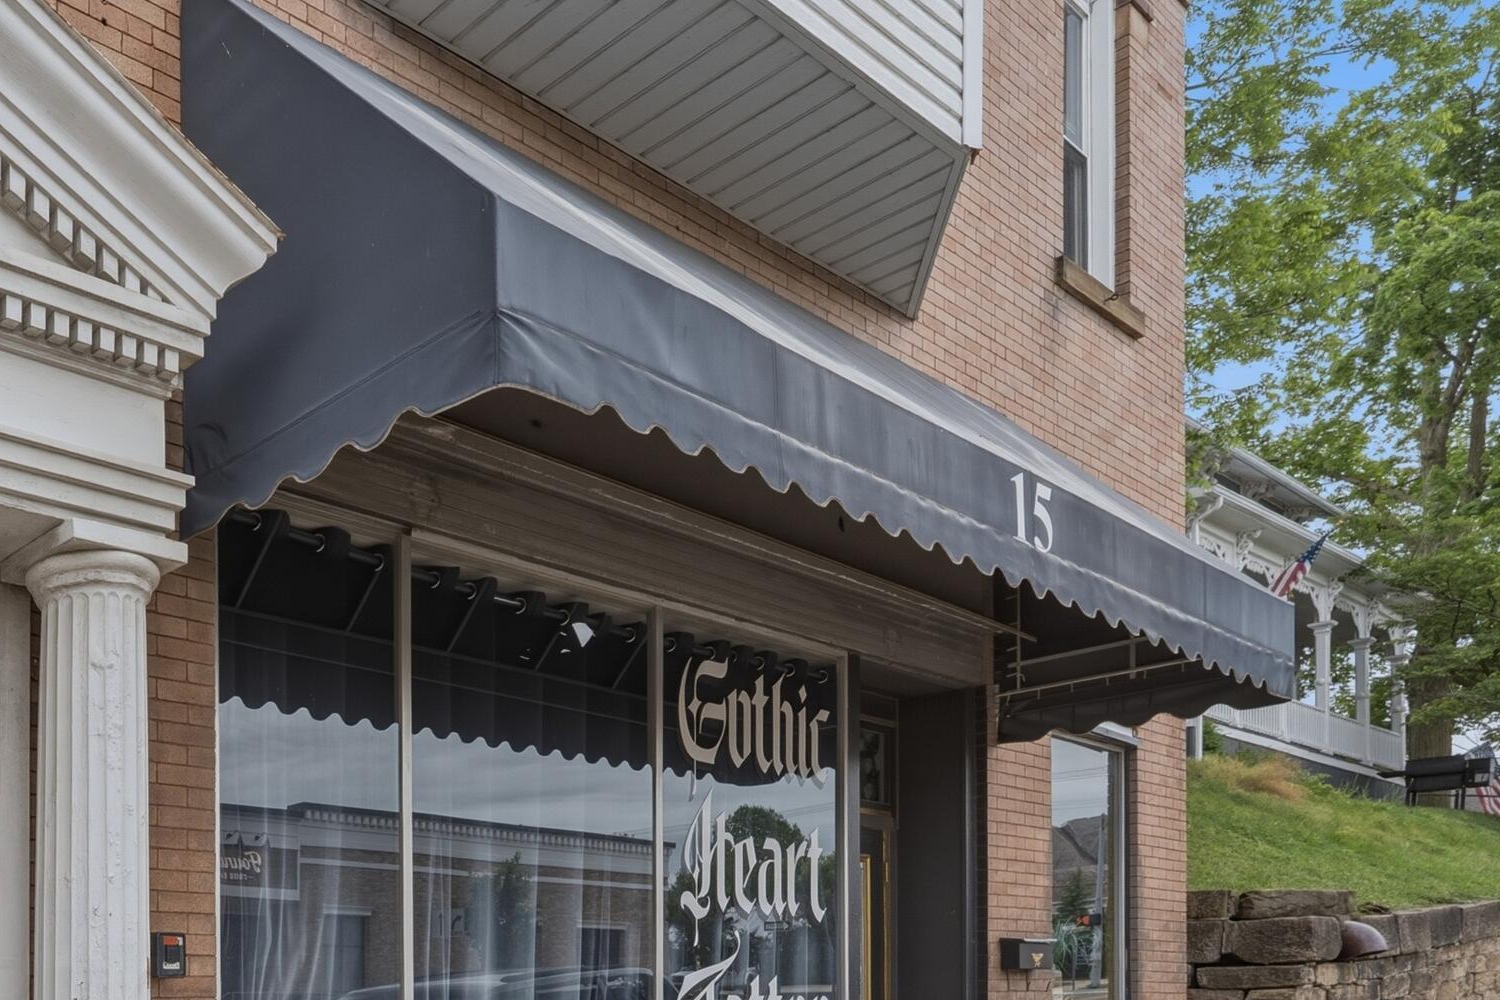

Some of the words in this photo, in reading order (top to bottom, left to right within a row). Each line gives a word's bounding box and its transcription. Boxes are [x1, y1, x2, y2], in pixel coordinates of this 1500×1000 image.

[1010, 472, 1053, 553] 15
[678, 657, 830, 792] Gothic
[681, 787, 827, 946] Heart
